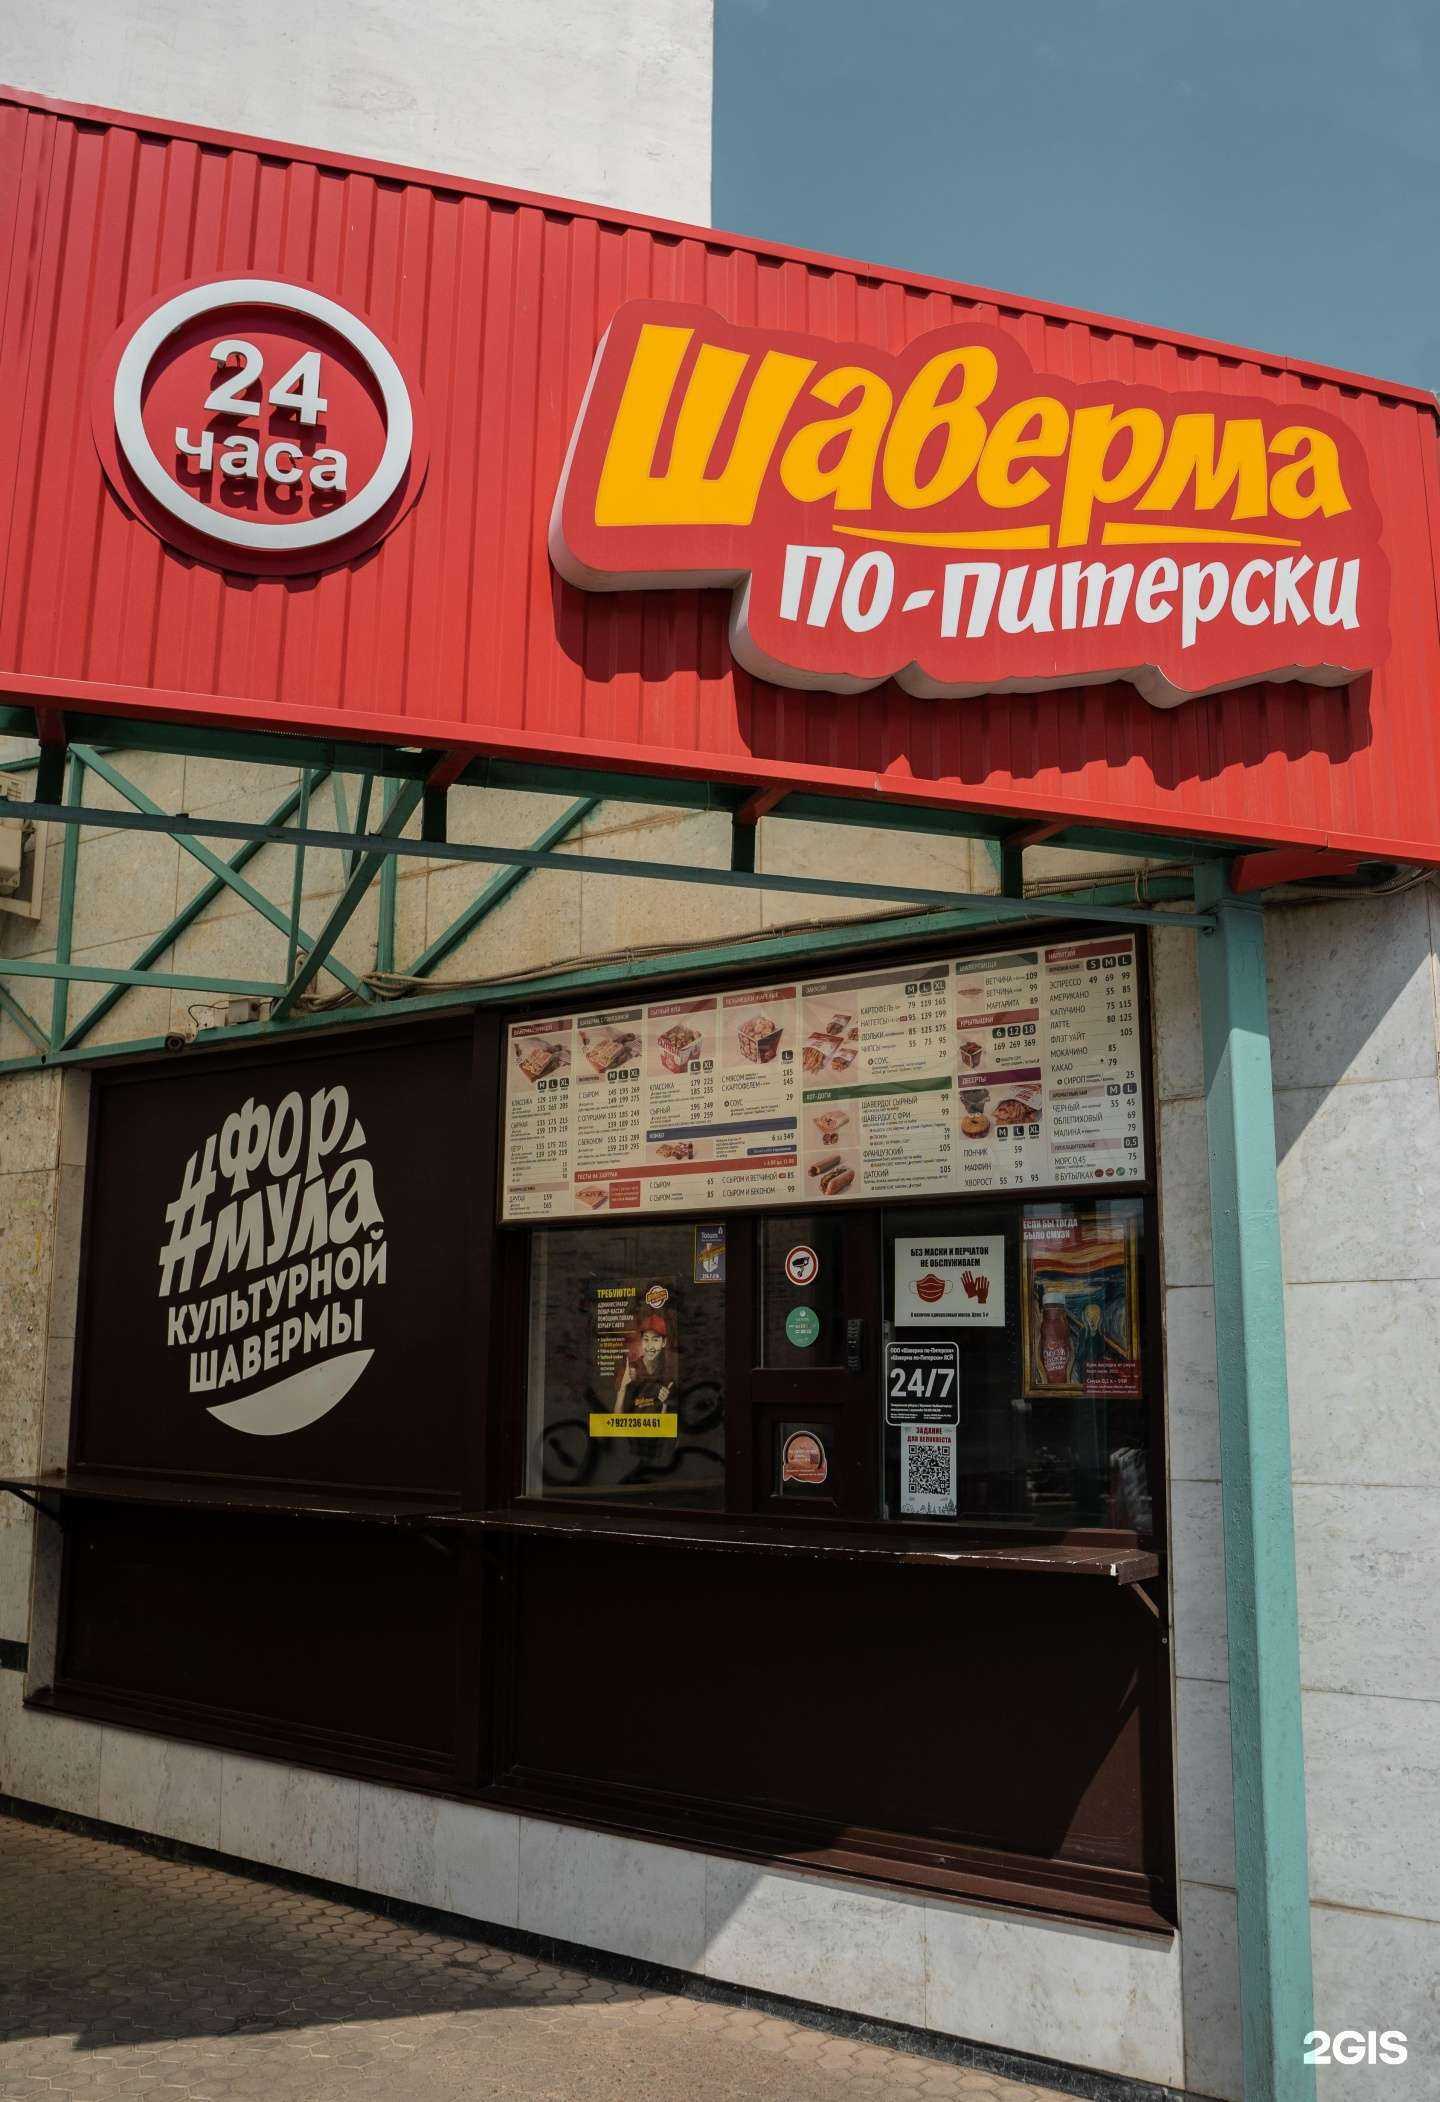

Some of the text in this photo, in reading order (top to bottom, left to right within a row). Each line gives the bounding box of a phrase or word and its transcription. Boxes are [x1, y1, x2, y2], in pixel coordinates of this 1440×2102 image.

[204, 339, 328, 425] 24
[595, 324, 1352, 548] Шаверма
[175, 426, 348, 492] часа
[779, 544, 1362, 648] по-питерски
[986, 972, 1038, 986] ВЕТЧИНА 109
[1050, 978, 1082, 989] ЭСПРЕССО
[1089, 976, 1098, 984] 49
[1122, 972, 1130, 980] 99
[986, 988, 1012, 998] ВЕТЧИНА
[1050, 990, 1089, 1002] АМЕРИКАНО
[1122, 985, 1130, 993] 85
[986, 1000, 1020, 1010] МАРГАРИТА
[1050, 1000, 1132, 1016] КАПУЧИНО 75 115
[860, 1006, 894, 1015] КАРТОФЕЛЬ
[1050, 1020, 1070, 1030] ЛАТТЕ
[1120, 1014, 1132, 1022] 125
[862, 1032, 884, 1042] ДОЛЬКИ
[1050, 1028, 1132, 1044] ФЛЭТ УАЙТ 105
[994, 1042, 1006, 1050] 169
[1024, 1040, 1036, 1048] 369
[1050, 1047, 1088, 1058] МОКАЧИНО
[1052, 1063, 1072, 1072] КАКАО
[1064, 1076, 1086, 1085] СИРОП
[893, 1096, 918, 1106] СЫРНЫЙ
[942, 1108, 950, 1116] 99
[1054, 1112, 1102, 1124] ОБЛЕПИХОВЫЙ
[1054, 1128, 1081, 1136] МАЛИНА
[864, 1144, 950, 1158] ФРАНЦУЗСКИЙ 105
[964, 1148, 988, 1156] ПОНЧИК
[864, 1166, 951, 1179] ДАТСКИЙ 105
[964, 1163, 992, 1172] МАФФИН
[750, 1172, 778, 1181] ВЕТЧИНОЙ
[1060, 1171, 1094, 1180] БУТЫЛКАХ
[965, 1178, 992, 1186] ХВОРОСТ
[726, 1189, 744, 1197] СЫРОМ
[1024, 1218, 1078, 1229] ЕСЛИ БЫ ТОГДА
[1024, 1230, 1070, 1240] БЫЛО СМУЗИ
[910, 1248, 922, 1256] БЕЗ
[924, 1248, 948, 1256] МАСКИ
[955, 1246, 989, 1256] ПЕРЧАТОК
[920, 1258, 980, 1268] НЕ ОБСЛУЖИВАЕМ
[168, 1228, 386, 1346] КУЛЬТУРНОЙ
[598, 1288, 636, 1298] ТРЕБУЮТСЯ
[190, 1298, 362, 1392] ШАВЕРМЫ
[890, 1368, 954, 1398] 24/7
[606, 1418, 614, 1427] +7
[616, 1418, 627, 1427] 927
[629, 1418, 642, 1427] 236
